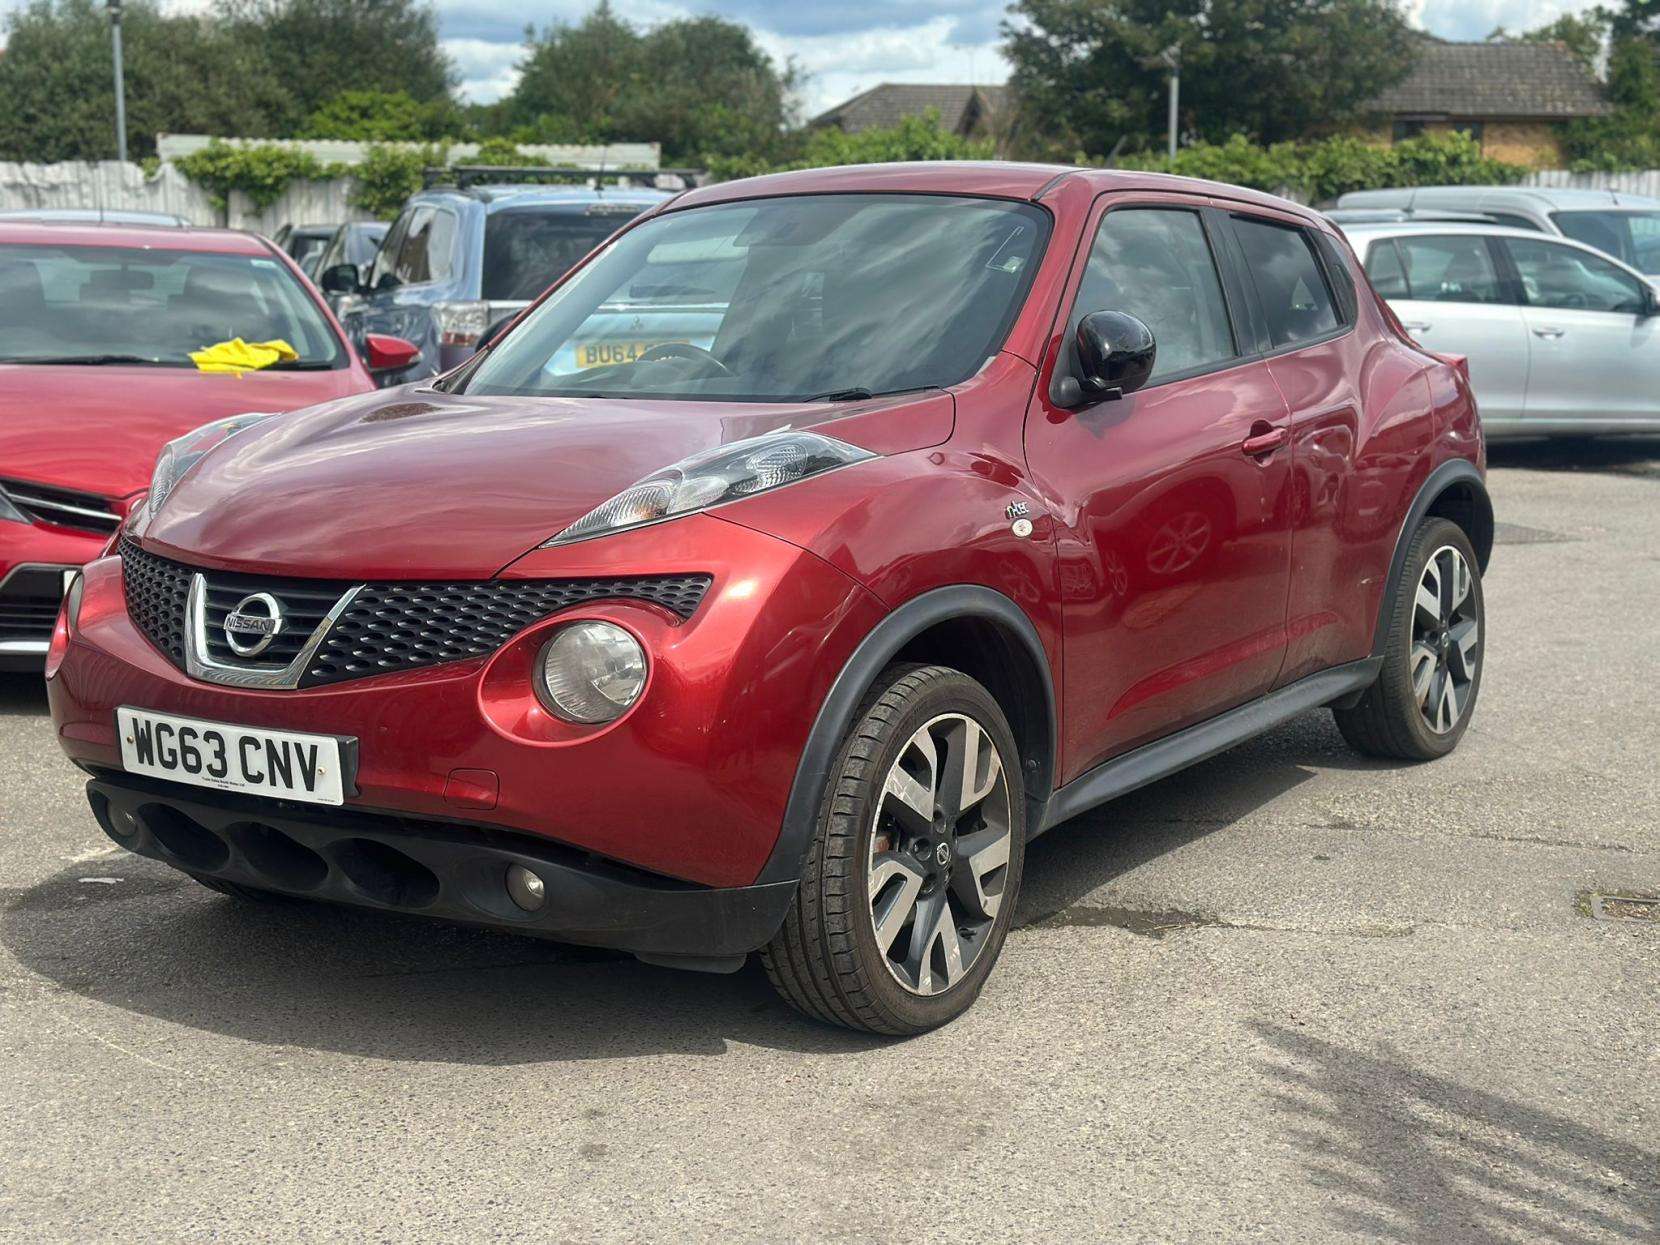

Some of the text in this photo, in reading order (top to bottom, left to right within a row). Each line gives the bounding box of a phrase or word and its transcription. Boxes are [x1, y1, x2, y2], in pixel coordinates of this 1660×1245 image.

[585, 344, 638, 364] BU64
[226, 615, 273, 632] NISSAN
[132, 717, 318, 792] WG63 CNV
